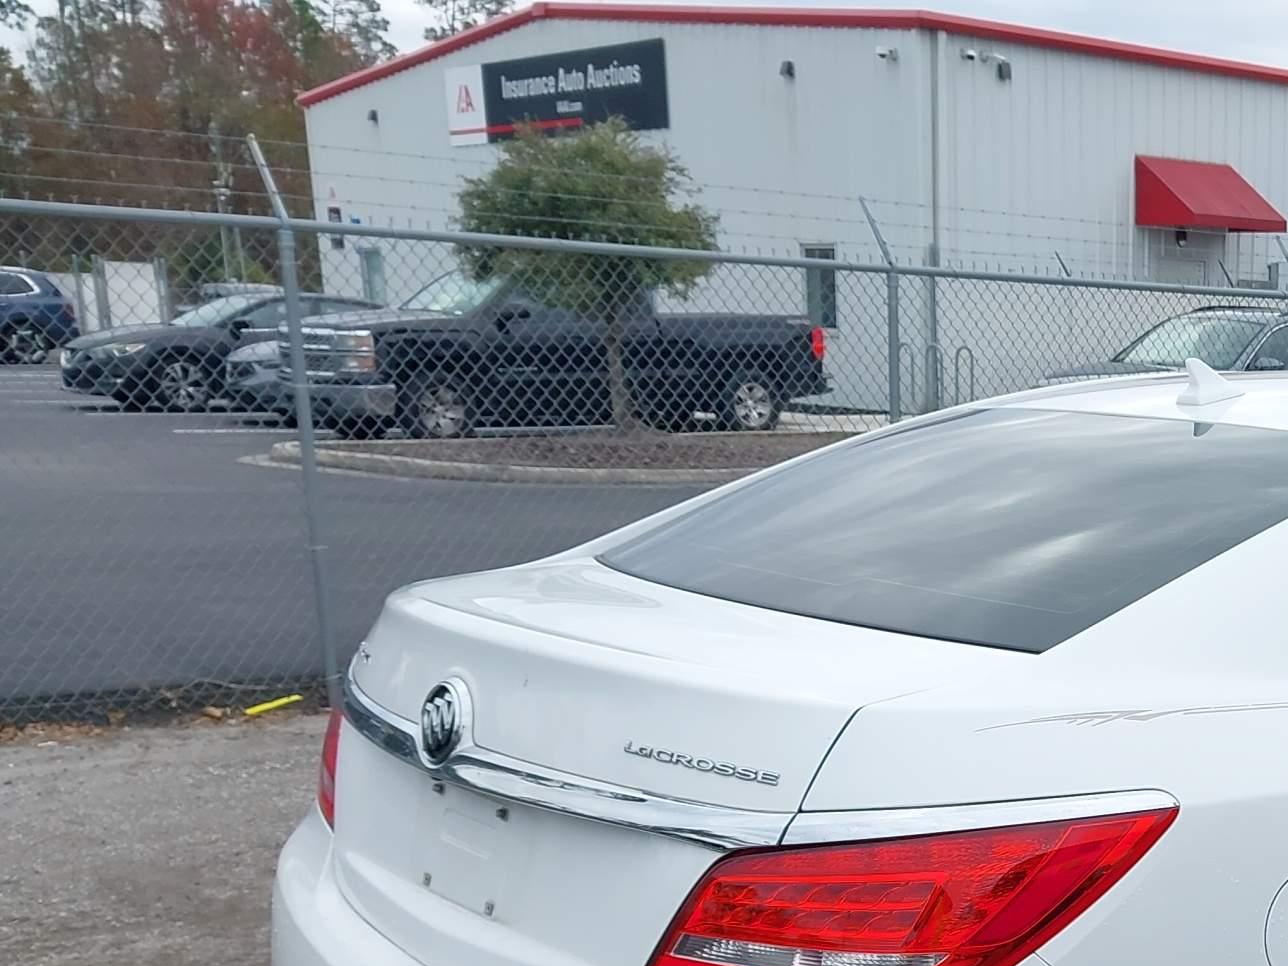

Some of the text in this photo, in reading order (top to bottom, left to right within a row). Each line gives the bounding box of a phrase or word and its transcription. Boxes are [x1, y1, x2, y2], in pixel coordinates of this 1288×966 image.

[501, 60, 641, 98] Insurance Auto Auctions
